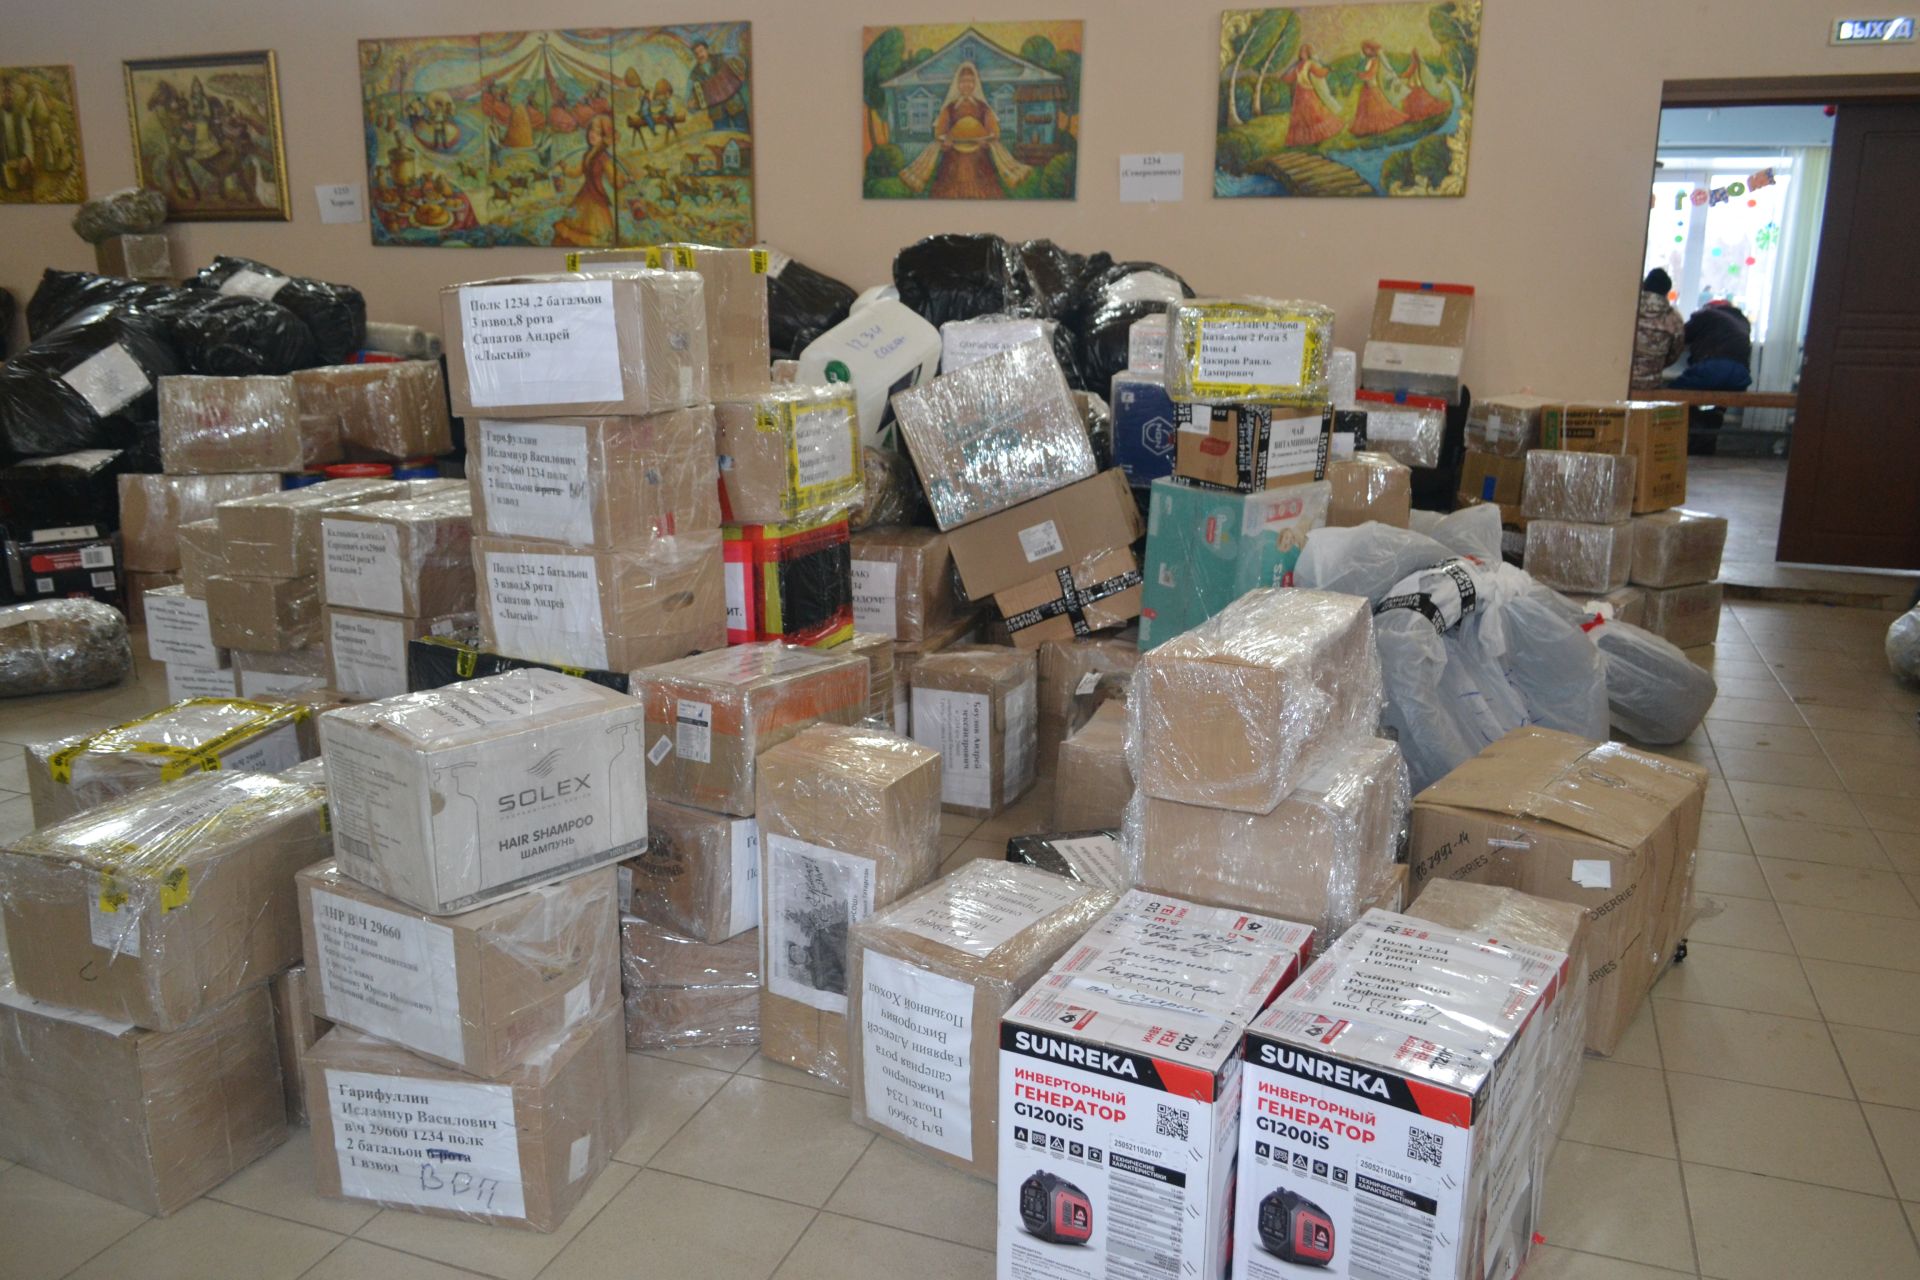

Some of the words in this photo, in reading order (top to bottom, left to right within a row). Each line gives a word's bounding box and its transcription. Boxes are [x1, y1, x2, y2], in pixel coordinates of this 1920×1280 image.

[470, 300, 500, 311] Полк
[504, 297, 530, 309] 1234
[547, 295, 602, 306] батальон
[472, 317, 478, 328] 3
[526, 314, 553, 328] рота
[526, 329, 570, 343] Андрей
[1258, 334, 1280, 342] Рота
[1282, 334, 1288, 342] 5
[475, 350, 531, 361] «Лысый»
[1231, 345, 1237, 353] 4
[526, 466, 545, 478] 1234
[493, 562, 516, 574] Полк
[517, 564, 535, 575] 1234
[547, 566, 588, 579] батальон
[533, 583, 553, 593] рота
[534, 597, 564, 610] Андрей
[499, 774, 592, 813] SOLEX
[499, 832, 529, 852] HAIR
[533, 814, 594, 844] SHAMPOO
[520, 836, 576, 860] ШАМПУНЬ
[370, 920, 401, 940] 29660
[1375, 936, 1413, 949] Полк
[1418, 944, 1449, 955] 1234
[1382, 946, 1449, 963] батальон
[1373, 959, 1413, 972] взвод
[1381, 953, 1419, 966] рота
[868, 982, 902, 1009] Хохол
[1349, 978, 1400, 993] Руслан
[903, 995, 964, 1028] Позывной
[1332, 1001, 1360, 1011] поз.
[1366, 1007, 1428, 1026] Старый
[867, 1021, 909, 1048] Алексей
[880, 1008, 947, 1045] Викторович
[875, 1045, 898, 1063] рота
[912, 1041, 964, 1068] Гарявин
[1015, 1031, 1139, 1079] SUNREKA
[901, 1060, 952, 1084] саперная
[1260, 1043, 1391, 1100] SUNREKA
[882, 1065, 945, 1101] Инженерно
[1014, 1067, 1126, 1106] ИНВЕРТОРНЫЙ
[339, 1085, 429, 1105] Гарифуллин
[886, 1086, 912, 1108] 1234
[1014, 1082, 1126, 1123] ГЕНЕРАТОР
[1258, 1080, 1376, 1127] ИНВЕРТОРНЫЙ
[342, 1102, 413, 1124] Исламнур
[417, 1111, 497, 1130] Василович
[888, 1106, 919, 1127] 29660
[916, 1100, 943, 1119] Полк
[1014, 1102, 1085, 1131] G1200iS
[922, 1122, 943, 1137] В/Ч
[1257, 1097, 1376, 1145] ГЕНЕРАТОР
[369, 1123, 408, 1140] 29660
[413, 1129, 444, 1142] 1234
[449, 1135, 484, 1147] полк
[1256, 1116, 1330, 1151] G1200iS
[347, 1138, 354, 1150] 2
[358, 1139, 422, 1159] батальон
[1114, 1139, 1162, 1160] 2505211030107
[351, 1156, 356, 1167] 1
[361, 1159, 399, 1174] взвод
[1111, 1154, 1155, 1172] ТЕХНИЧЕСКИЕ
[1111, 1161, 1167, 1181] ХАРАКТЕРИСТИКИ
[1360, 1159, 1412, 1184] 2505211030419
[1357, 1183, 1417, 1208] ХАРАКТЕРИСТИКИ
[1358, 1176, 1404, 1197] ТЕХНИЧЕСКИЕ
